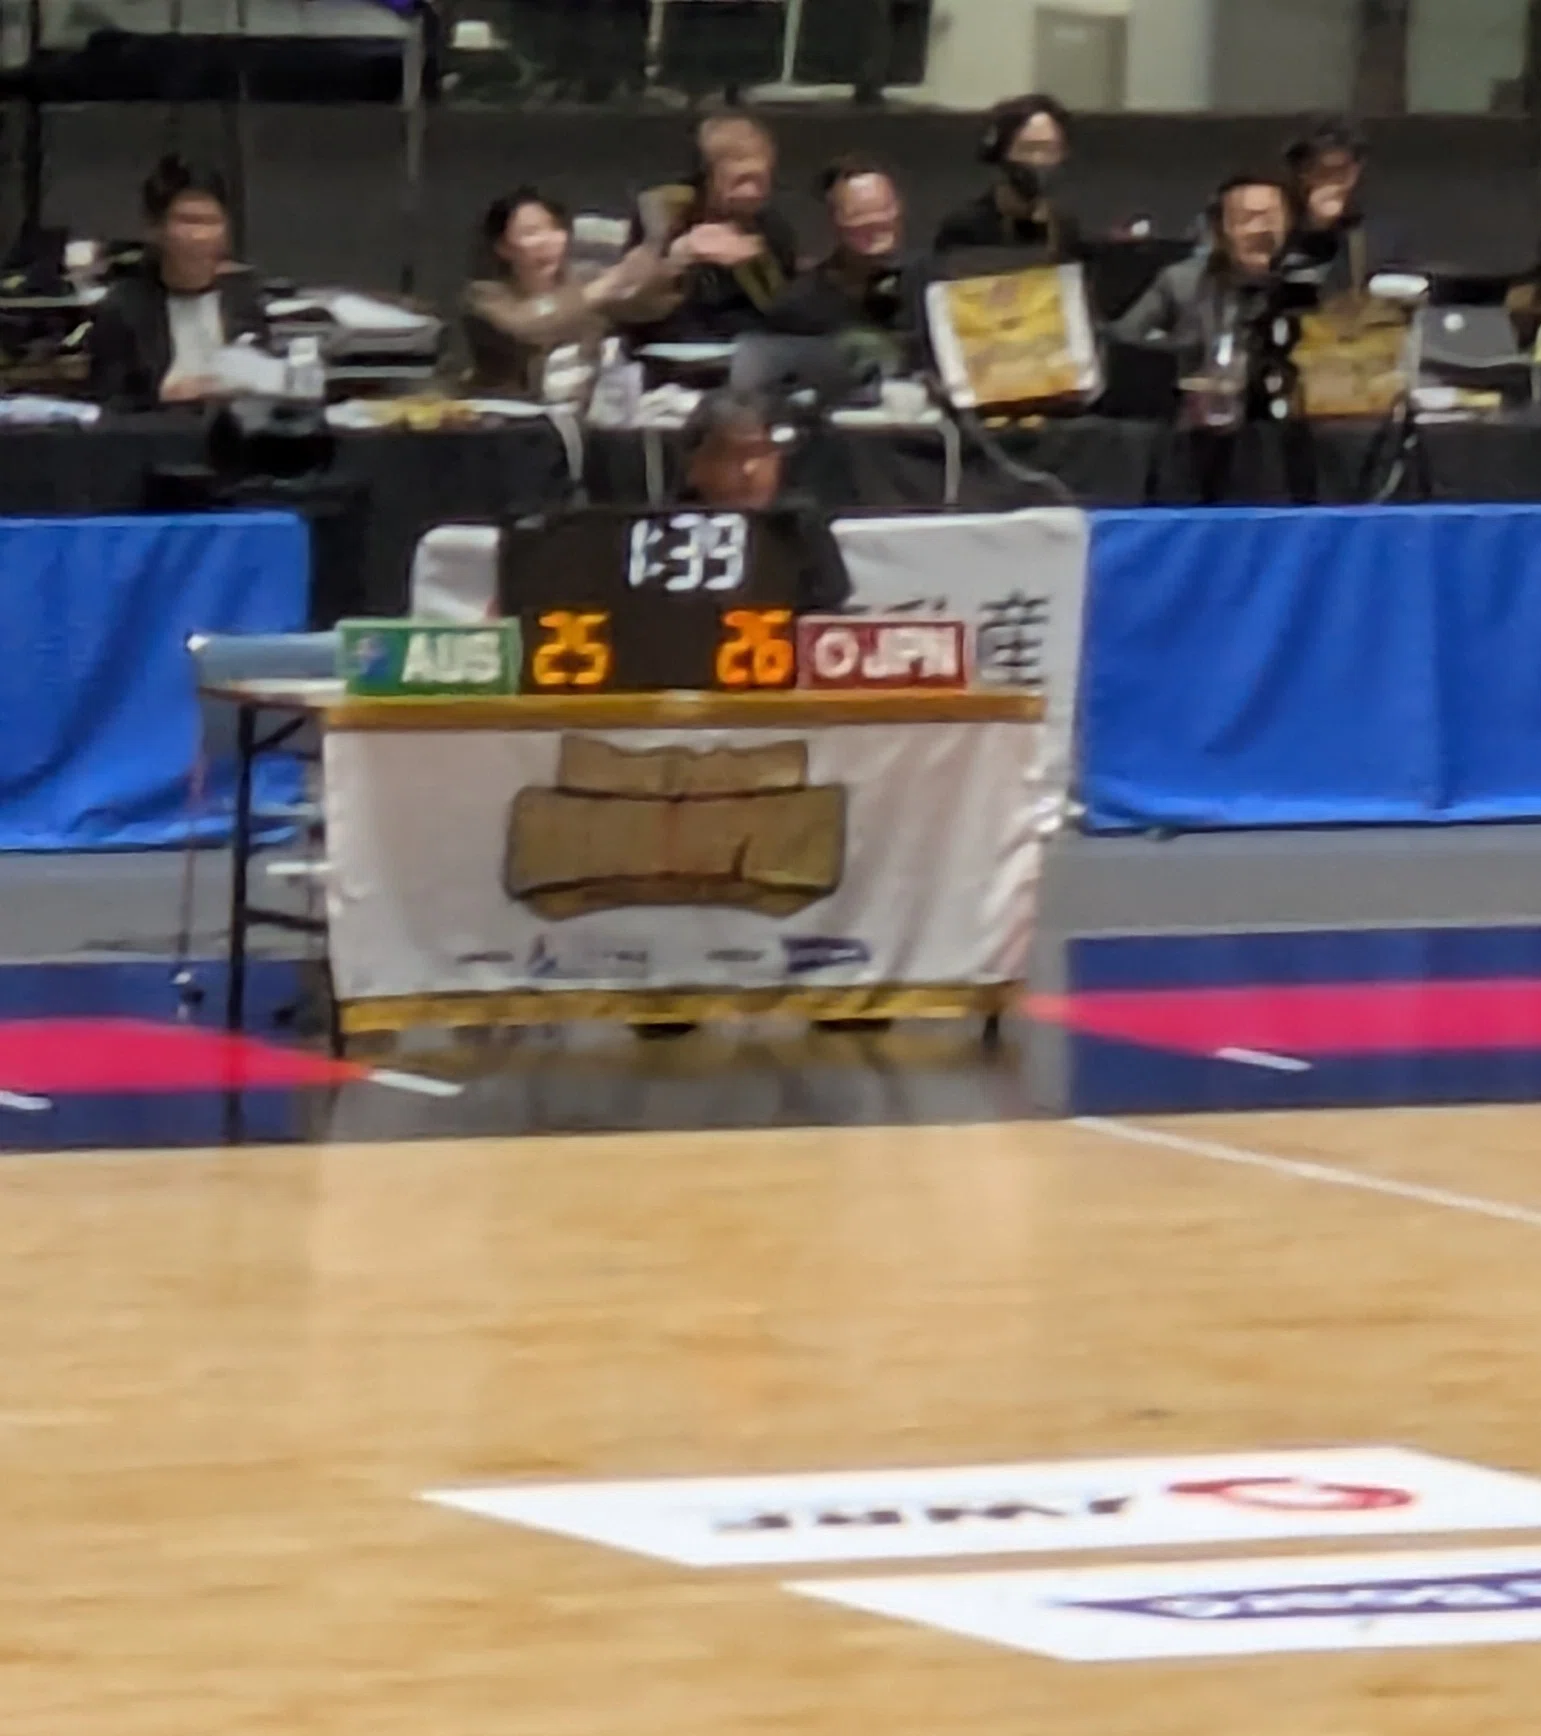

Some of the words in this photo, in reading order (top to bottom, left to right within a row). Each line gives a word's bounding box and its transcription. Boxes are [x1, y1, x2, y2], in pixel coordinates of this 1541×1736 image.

[629, 513, 747, 590] 1:39
[403, 632, 500, 683] AUS
[533, 610, 612, 685] 25
[862, 626, 956, 678] JPN
